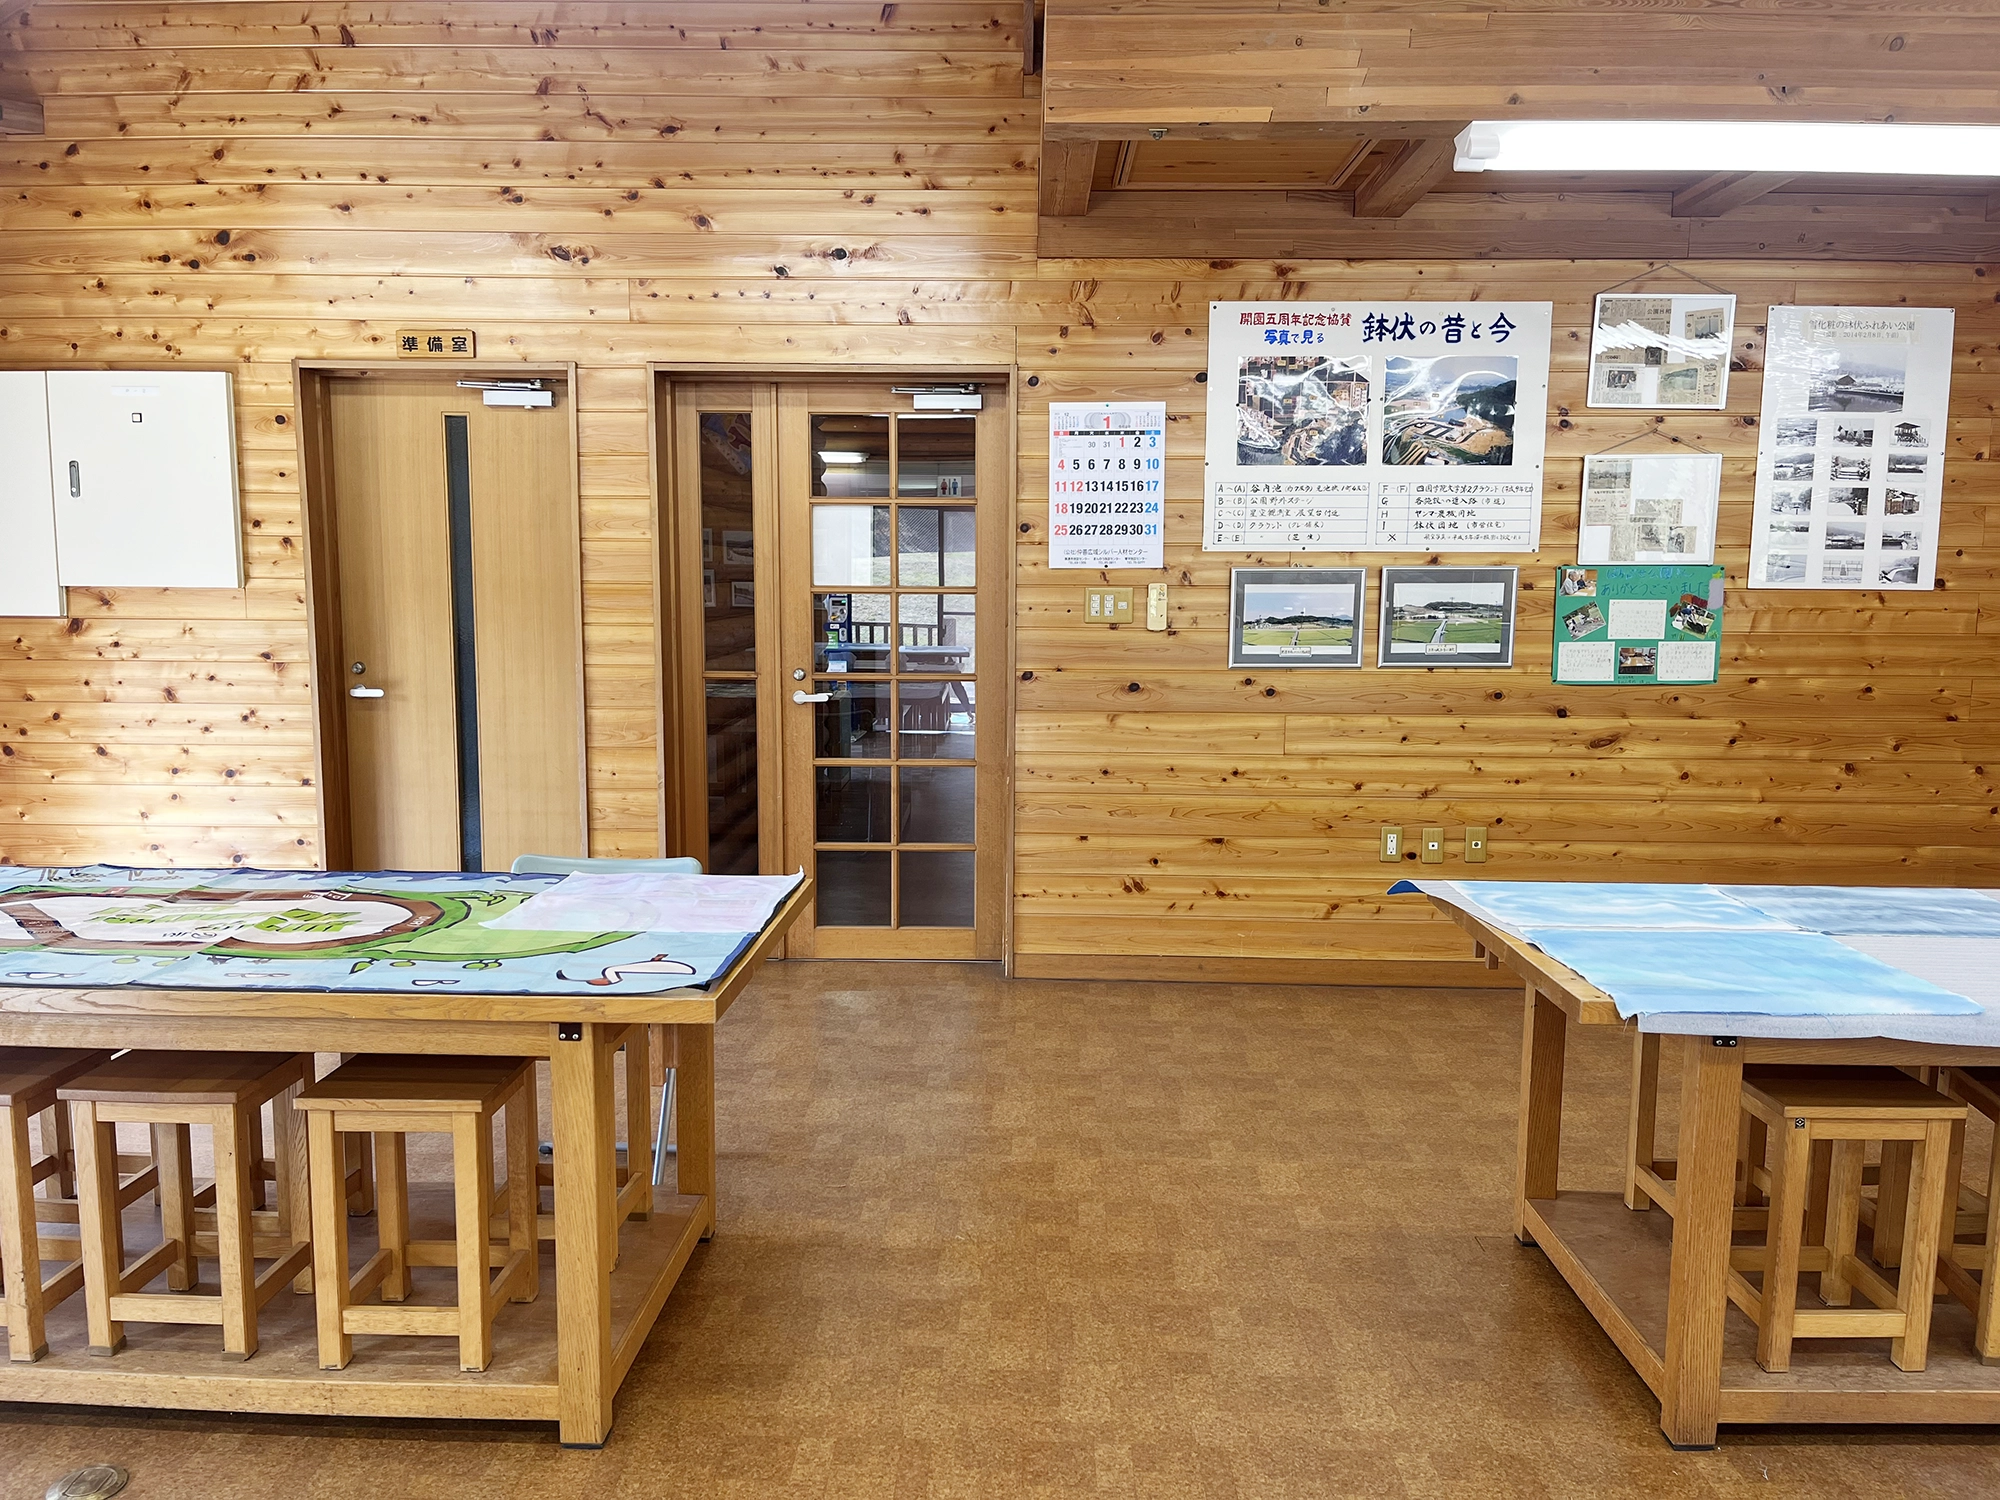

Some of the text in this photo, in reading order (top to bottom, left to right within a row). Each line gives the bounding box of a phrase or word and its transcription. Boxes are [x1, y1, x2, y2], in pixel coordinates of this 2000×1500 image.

[1239, 312, 1352, 327] 開園五周年記念協賛
[1362, 311, 1517, 344] 鉢伏の昔と今
[1264, 329, 1325, 345] 写真で見る
[402, 336, 468, 352] 準備室
[1103, 416, 1110, 429] 1
[1119, 437, 1125, 448] 1
[1134, 437, 1141, 448] 2
[1149, 437, 1156, 448] 3
[1058, 459, 1159, 470] 4 5 6 7 8 9 10
[1055, 481, 1159, 492] 11 12 13 14 15 16 17
[1055, 503, 1158, 514] 18 19 20 21 22 23 24
[1381, 510, 1388, 518] H
[1054, 524, 1157, 536] 25 26 27 28 29 30 31
[1601, 581, 1709, 596] ありがとうございました
